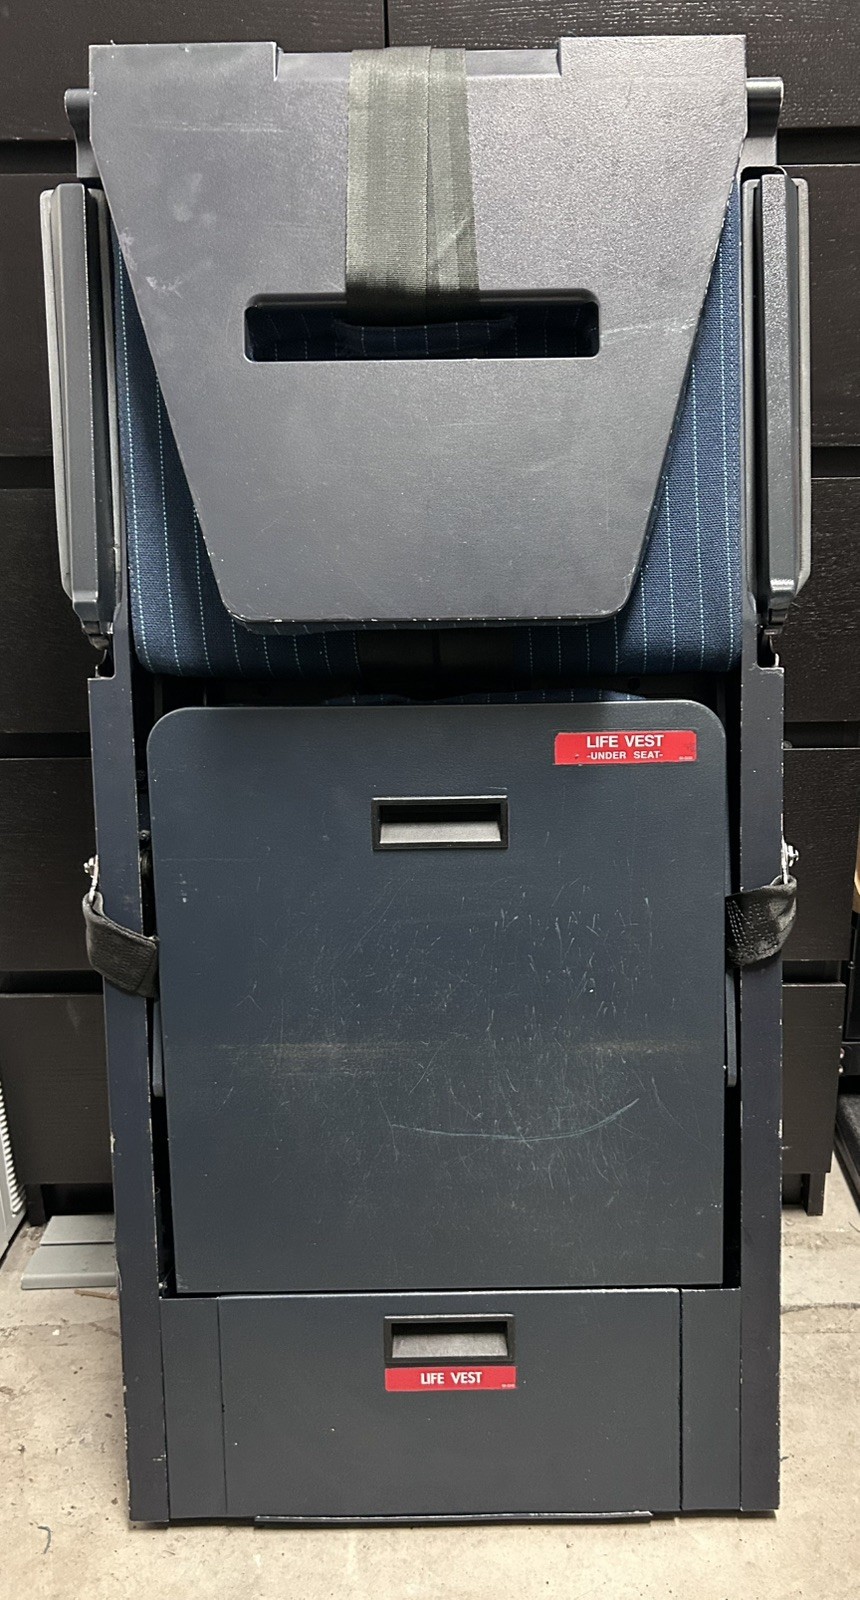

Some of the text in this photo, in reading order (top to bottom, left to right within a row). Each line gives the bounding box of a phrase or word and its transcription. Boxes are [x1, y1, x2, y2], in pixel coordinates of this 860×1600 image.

[586, 734, 664, 748] LIFE VEST
[586, 750, 664, 760] -UNDER SEAT-
[420, 1371, 482, 1385] LIFE VEST
